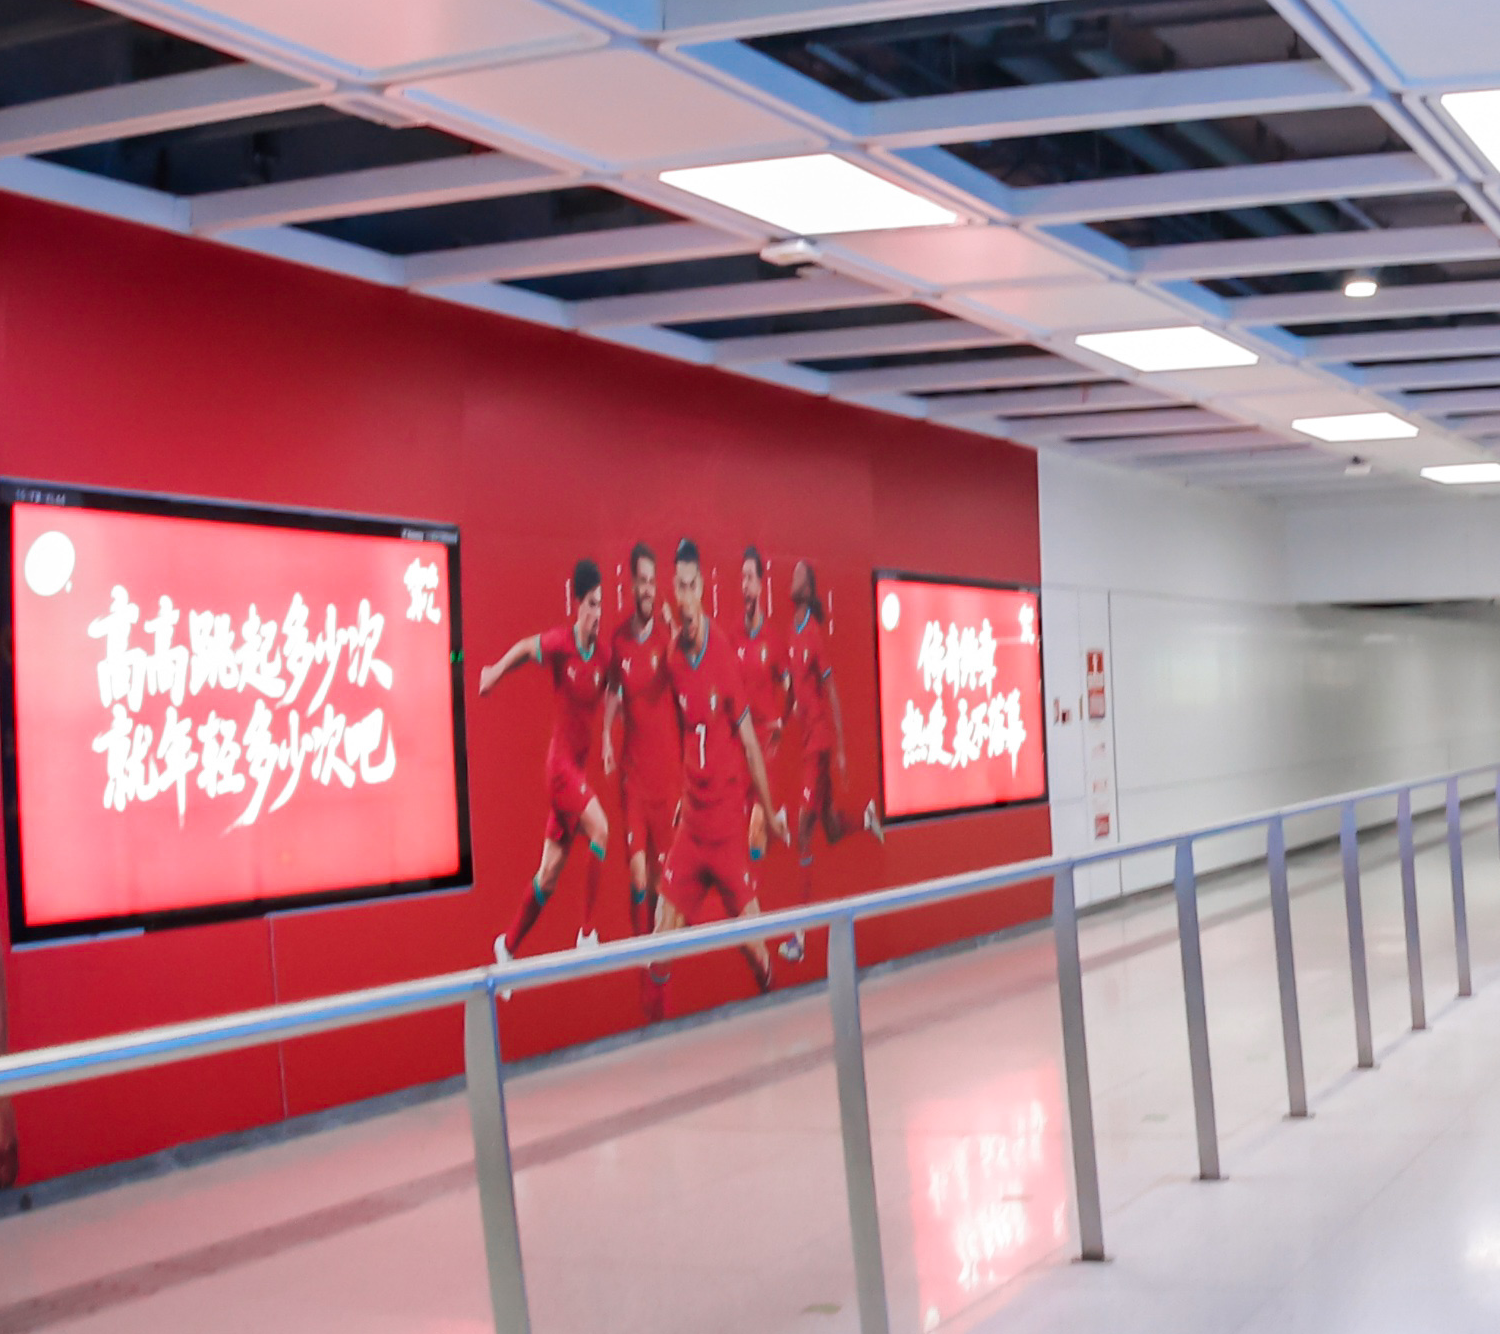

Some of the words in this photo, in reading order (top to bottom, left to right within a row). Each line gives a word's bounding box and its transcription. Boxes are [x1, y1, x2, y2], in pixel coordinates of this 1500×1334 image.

[87, 584, 394, 717] 高高跳起多少次
[91, 698, 397, 834] 就年轻多少次吧
